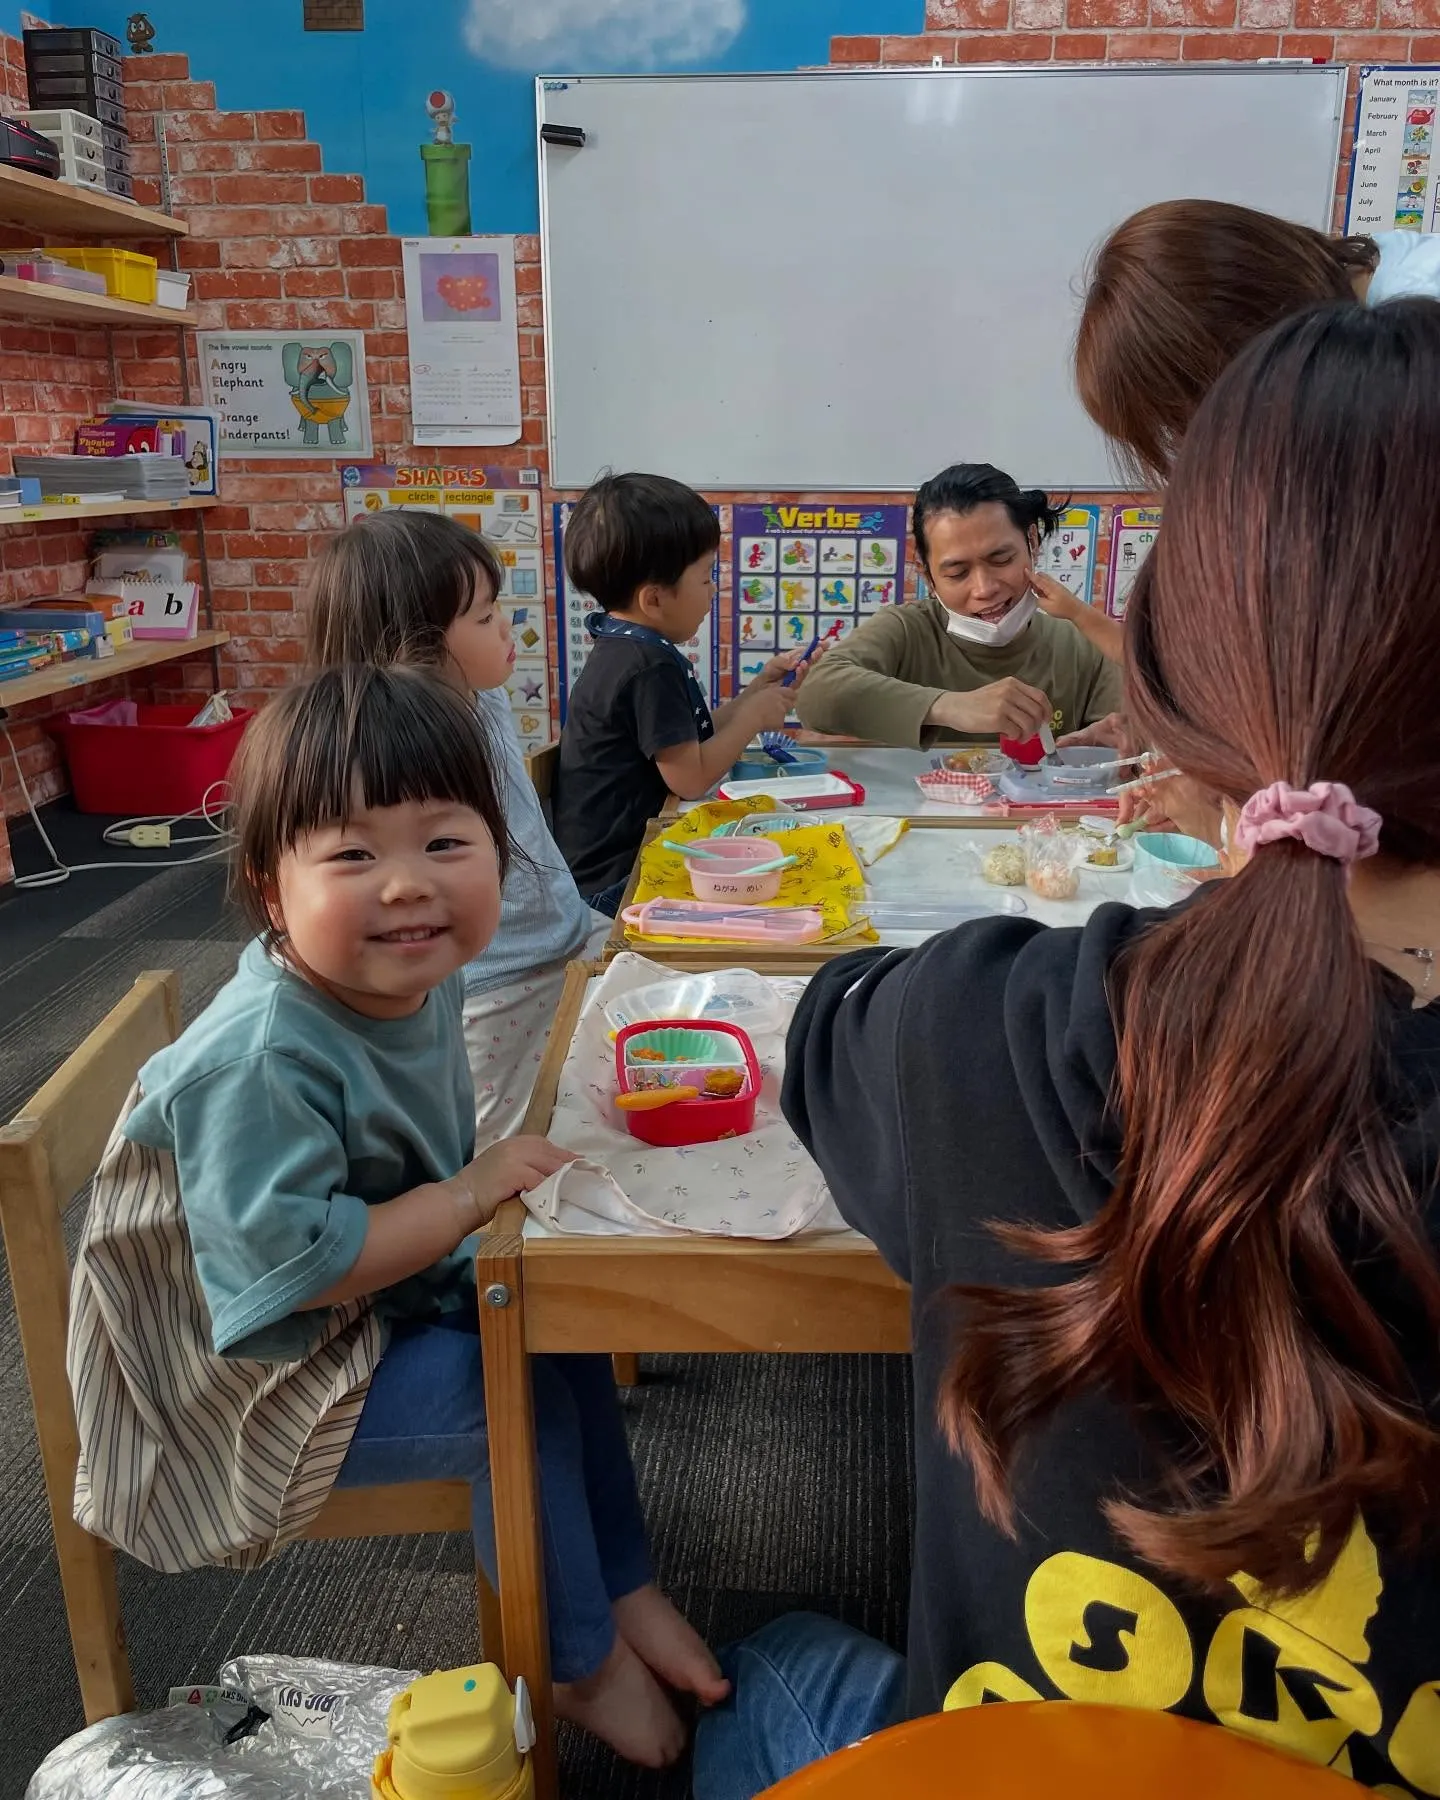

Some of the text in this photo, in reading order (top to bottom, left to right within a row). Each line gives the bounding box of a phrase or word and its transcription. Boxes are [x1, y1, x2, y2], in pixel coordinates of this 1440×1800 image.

[1373, 79, 1439, 87] What month is it?
[1368, 95, 1397, 104] January
[1367, 113, 1399, 121] February
[1364, 147, 1381, 155] April
[1362, 164, 1377, 172] May
[1358, 198, 1374, 206] July
[1356, 215, 1382, 223] August
[208, 343, 219, 351] The
[211, 358, 247, 373] Angry
[212, 376, 264, 391] Elephant
[214, 394, 227, 405] In
[219, 428, 290, 442] Underpants!
[396, 468, 487, 488] SHAPES
[407, 490, 436, 502] circle
[445, 491, 493, 503] rectangle
[777, 506, 861, 528] Verbs
[1062, 531, 1074, 544] gl
[1139, 532, 1153, 543] ch
[1059, 574, 1072, 582] cr
[128, 592, 183, 616] a b
[220, 1689, 236, 1701] SKY
